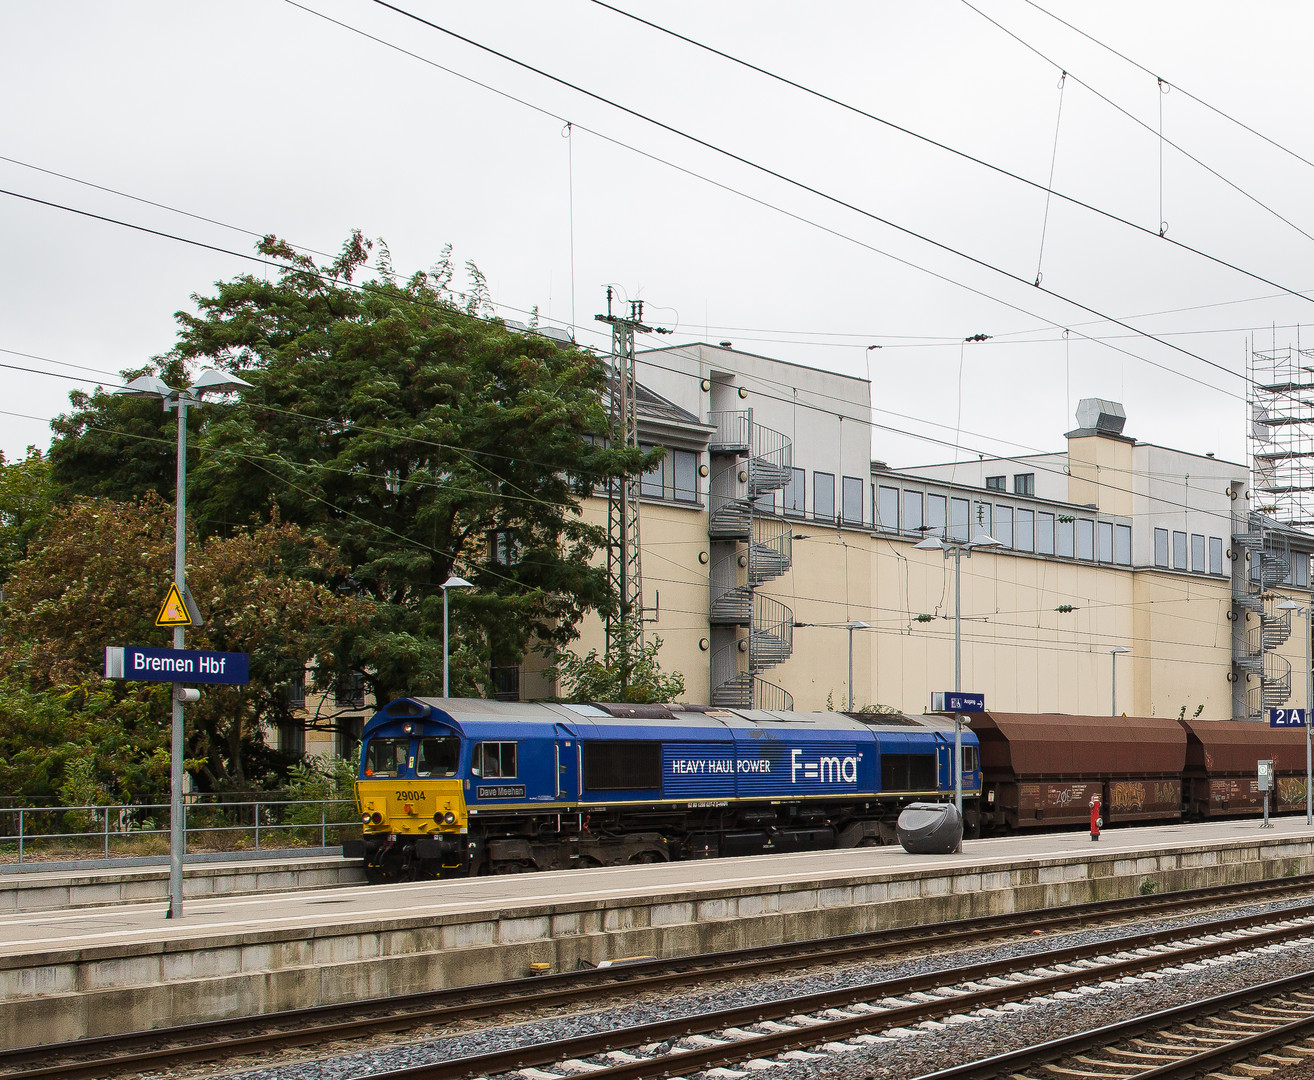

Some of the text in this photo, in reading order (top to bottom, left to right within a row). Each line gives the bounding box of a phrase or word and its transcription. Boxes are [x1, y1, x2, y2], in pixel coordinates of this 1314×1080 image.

[133, 652, 226, 675] Bremen Hbf
[1276, 709, 1301, 724] 2 A
[672, 760, 771, 774] HEAVY HAUL POWER
[791, 749, 857, 783] F=ma
[395, 790, 427, 801] 29004
[479, 786, 523, 797] Dave Meehan
